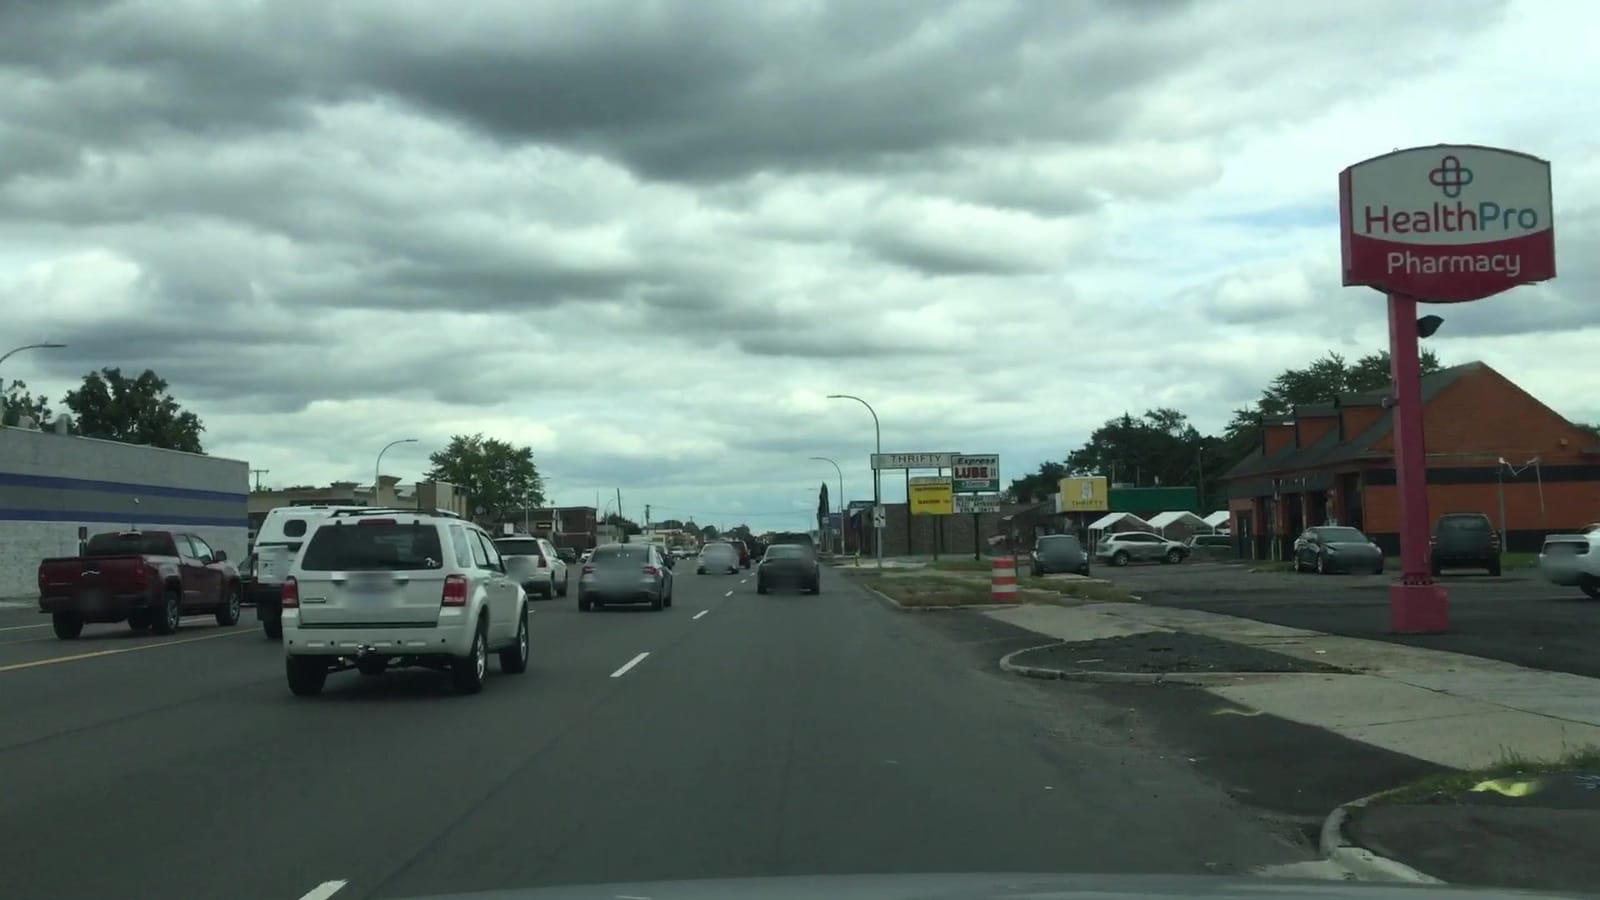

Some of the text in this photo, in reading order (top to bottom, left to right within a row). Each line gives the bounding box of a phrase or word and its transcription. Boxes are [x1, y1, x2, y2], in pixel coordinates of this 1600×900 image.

[1365, 201, 1538, 233] HealthPro
[1387, 250, 1521, 277] Pharmacy
[891, 455, 941, 463] THRIFTY
[958, 457, 995, 465] Express
[955, 467, 988, 478] LUBE
